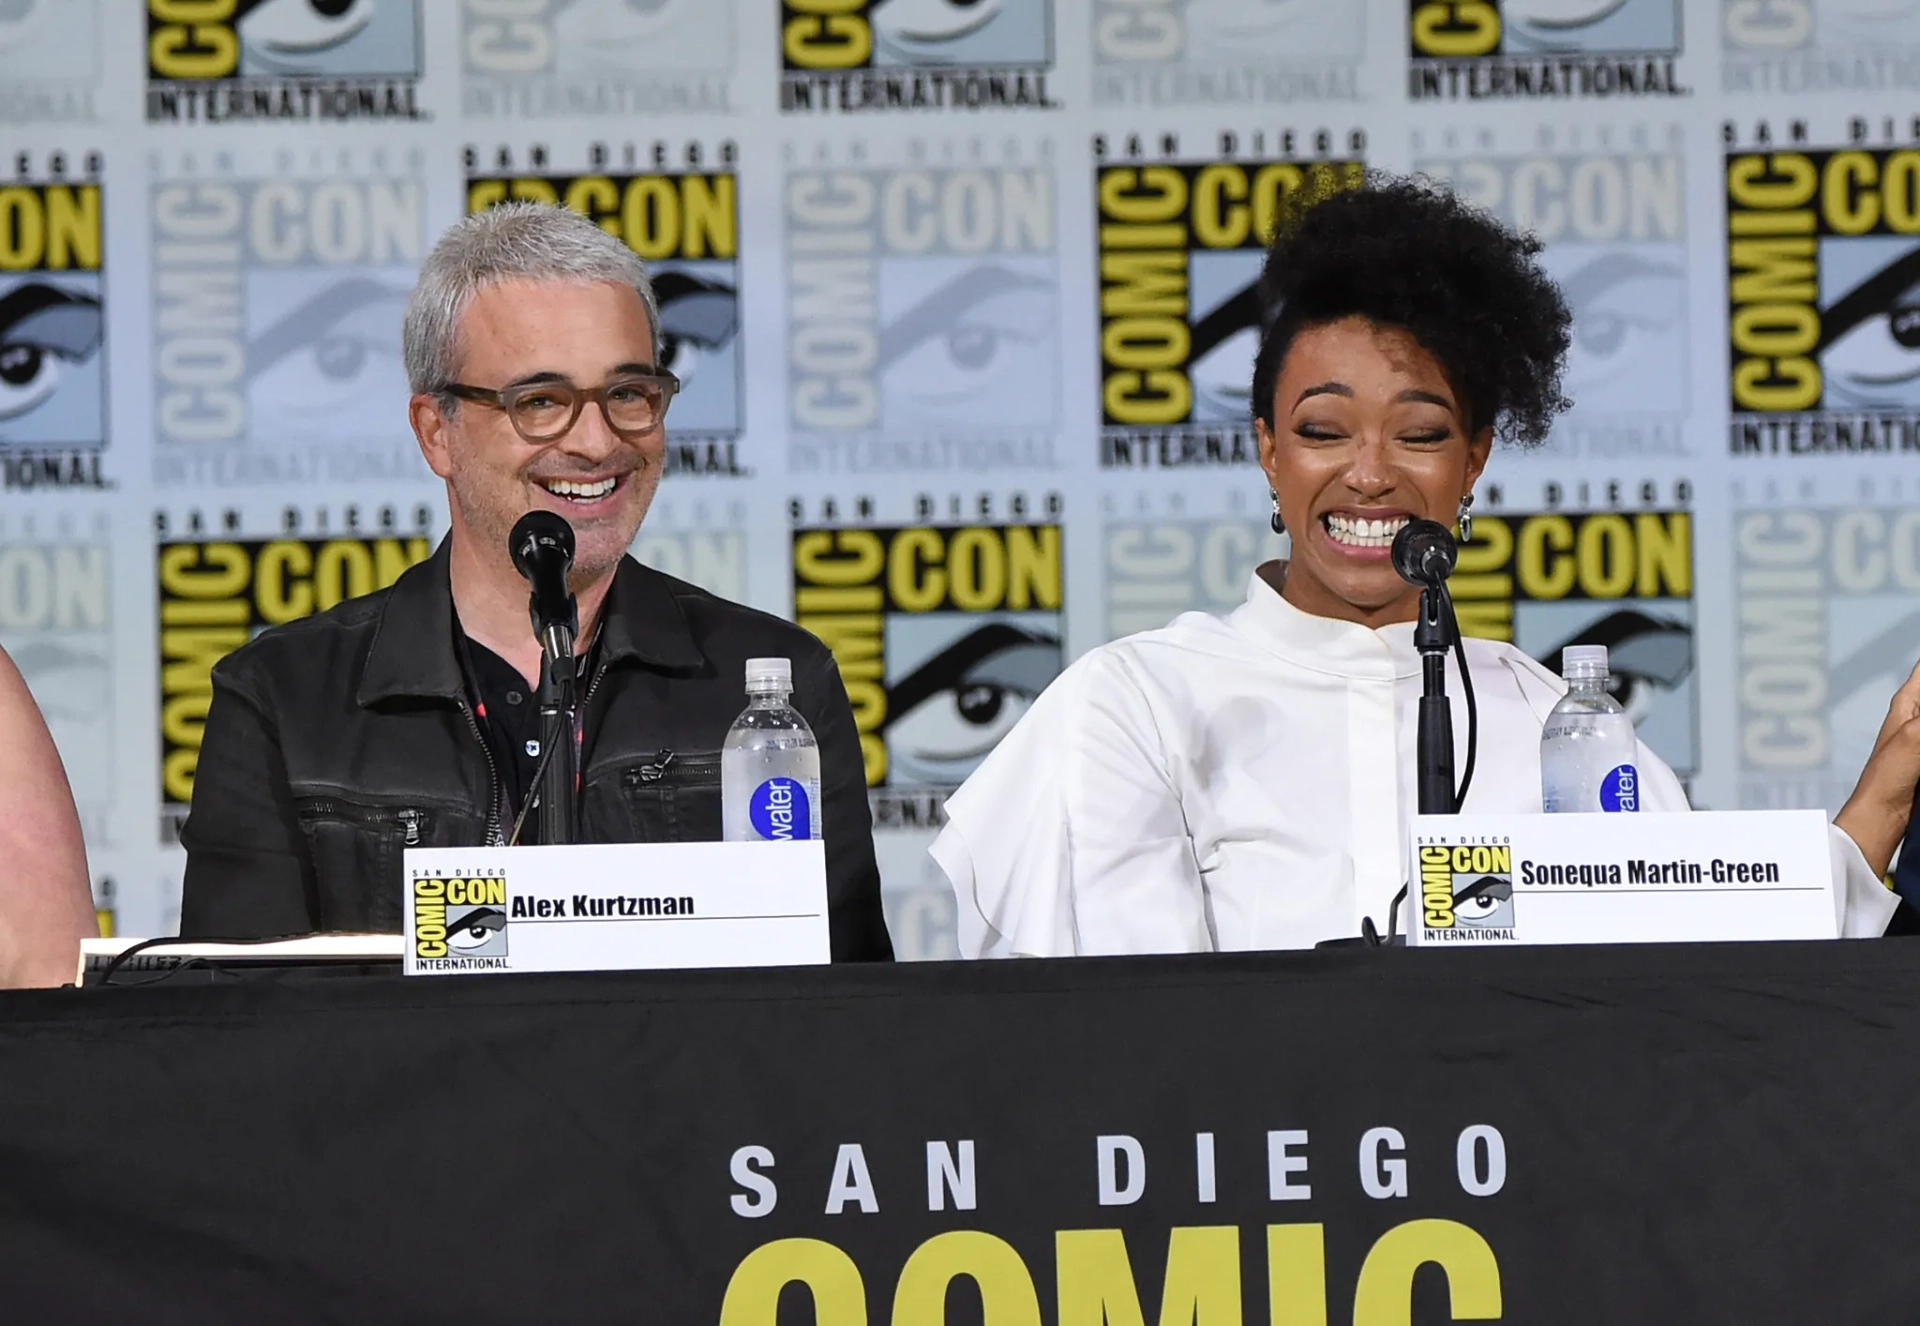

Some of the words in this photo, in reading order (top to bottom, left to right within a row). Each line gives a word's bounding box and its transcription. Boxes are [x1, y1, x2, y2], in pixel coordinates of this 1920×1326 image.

[0, 185, 100, 271] ON
[250, 184, 420, 264] CON
[883, 173, 1050, 252] CON
[1823, 151, 1920, 235] CO
[156, 185, 245, 440] COMIC
[790, 174, 879, 430] COMIC
[1101, 166, 1191, 424] COMIC
[1729, 153, 1823, 412] COMIC
[787, 496, 875, 520] SAN
[914, 490, 1064, 516] DIEGO
[0, 546, 104, 628] ON
[888, 527, 1062, 612] CON
[1517, 515, 1691, 598] CON
[1738, 511, 1827, 770] COMIC
[412, 869, 441, 877] SAN
[455, 868, 505, 876] DIEGO
[1452, 846, 1510, 873] CON
[1460, 836, 1510, 844] DIEGO
[1520, 859, 1622, 887] Sonequa
[1627, 858, 1780, 884] Martin-Green
[415, 879, 448, 957] COMIC
[447, 878, 505, 905] CON
[511, 895, 566, 918] Alex
[572, 895, 694, 917] Kurtzman
[1420, 847, 1454, 927] COMIC
[729, 1140, 977, 1217] SAN
[1097, 1124, 1507, 1206] DIEGO
